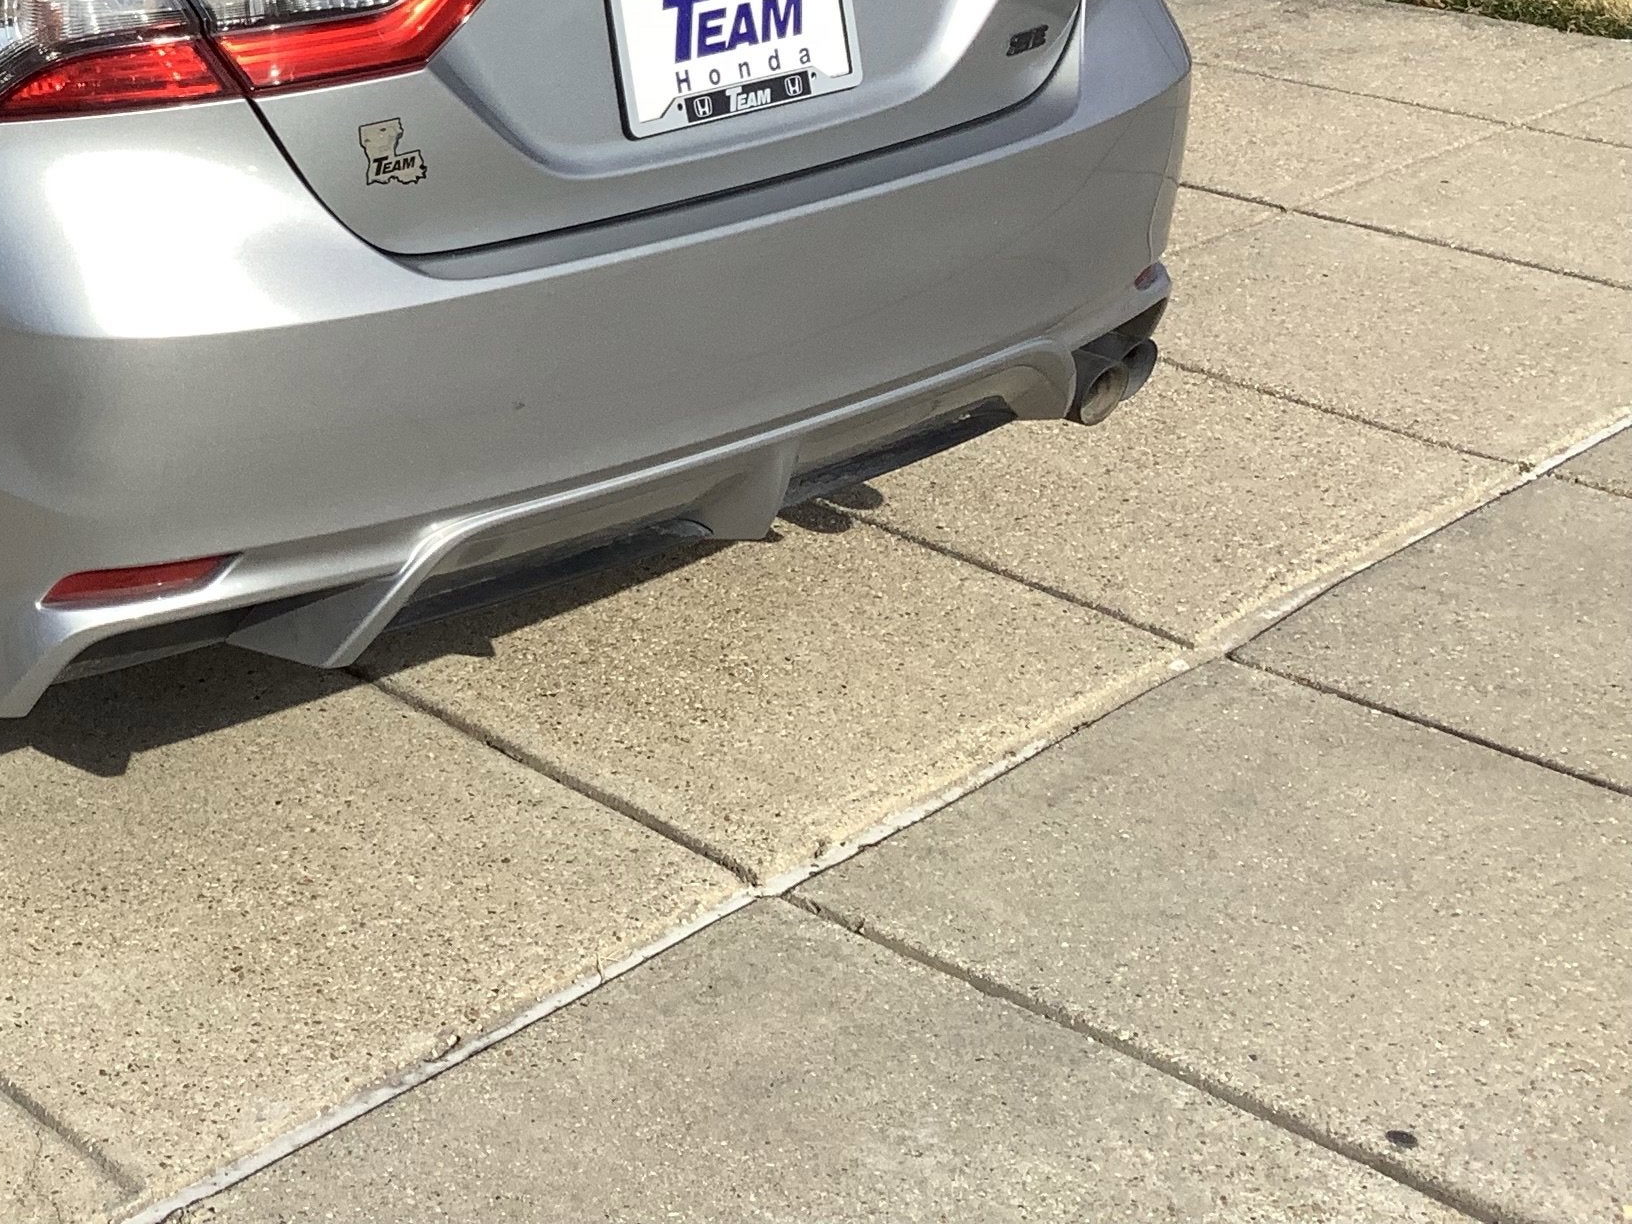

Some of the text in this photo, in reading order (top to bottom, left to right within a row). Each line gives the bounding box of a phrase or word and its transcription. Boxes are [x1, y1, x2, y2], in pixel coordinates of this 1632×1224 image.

[676, 47, 811, 94] Honda
[725, 85, 771, 113] TEAM
[373, 155, 415, 177] TEAM
